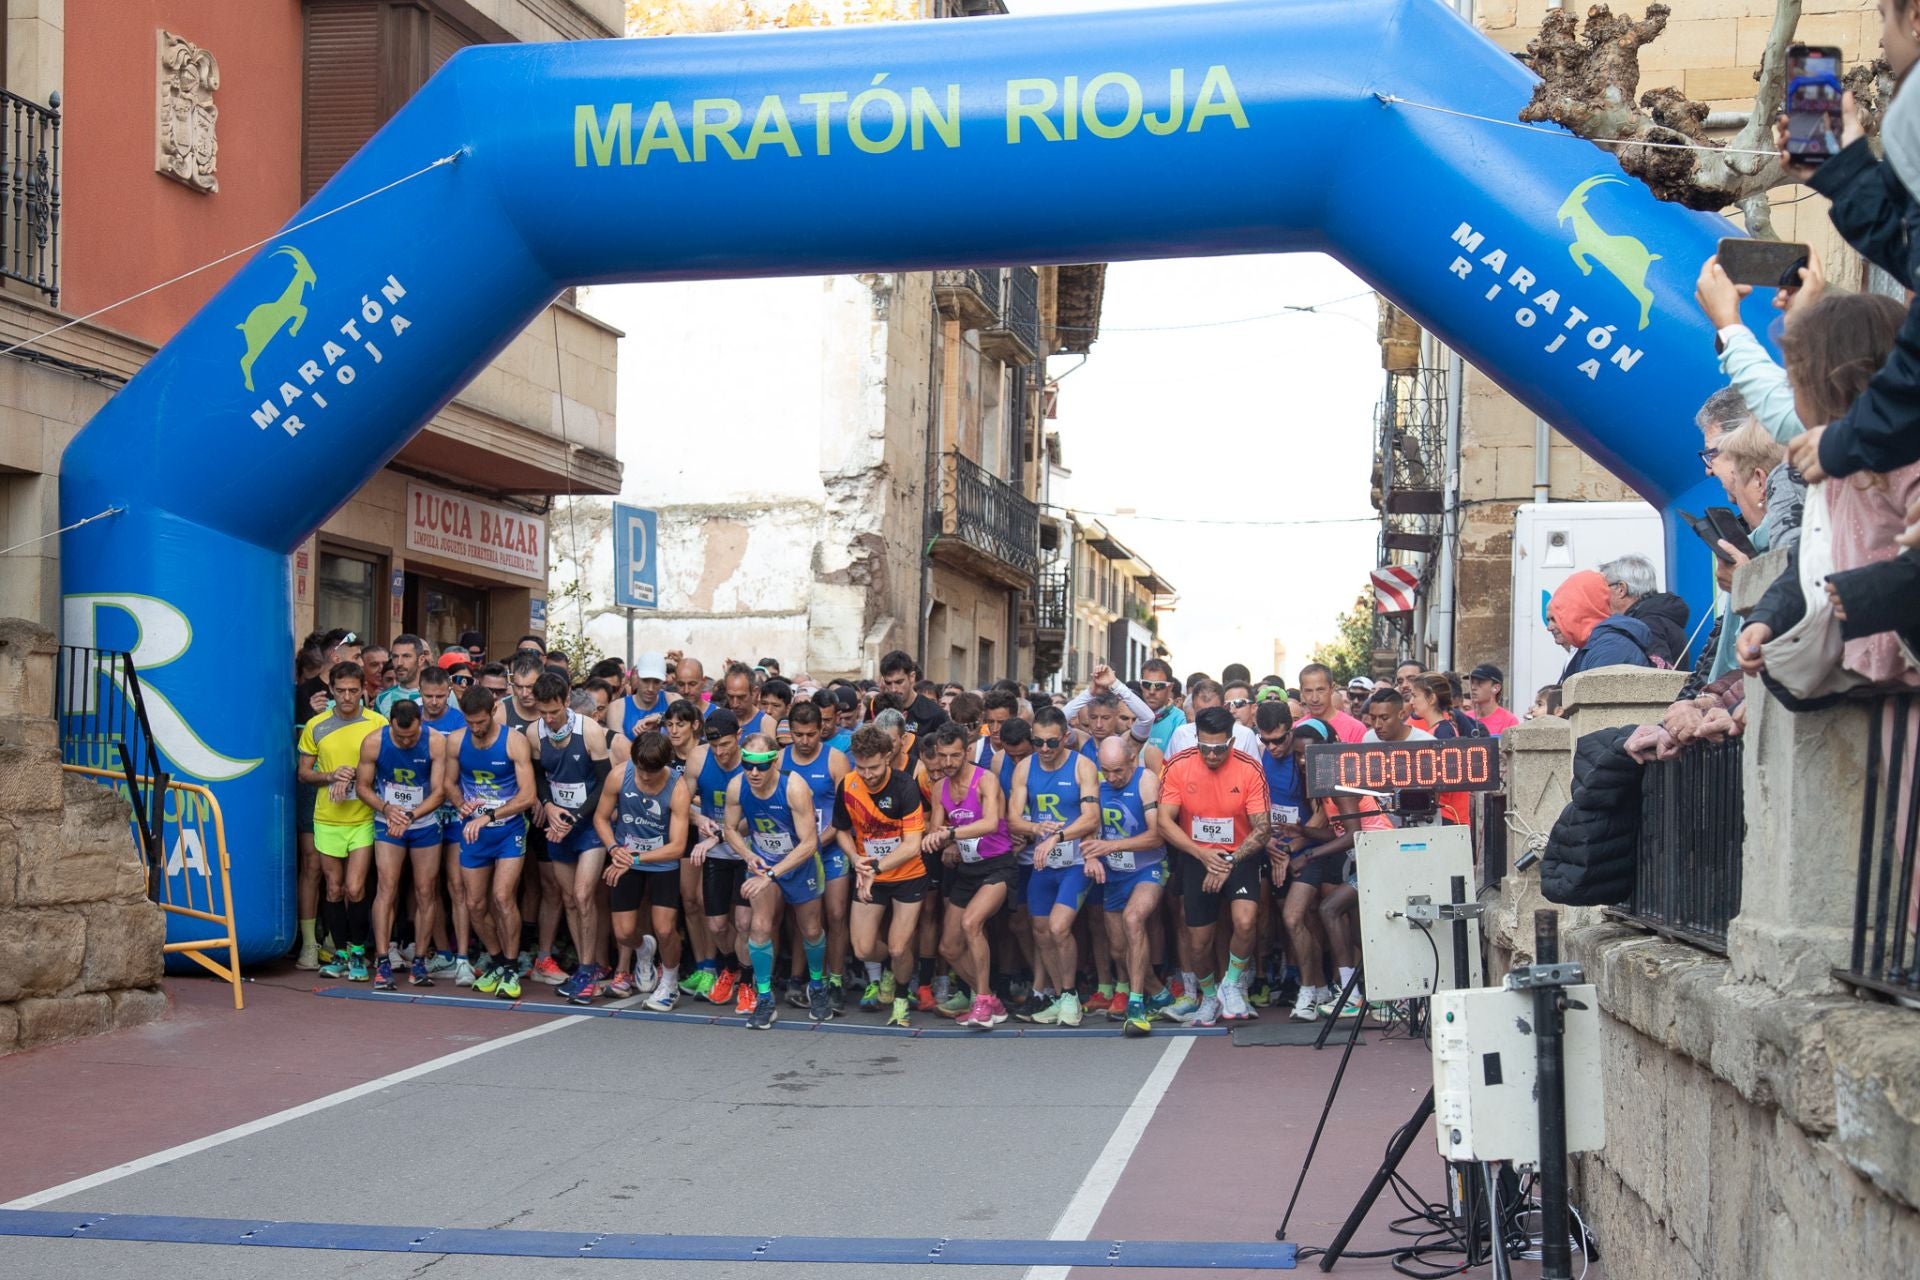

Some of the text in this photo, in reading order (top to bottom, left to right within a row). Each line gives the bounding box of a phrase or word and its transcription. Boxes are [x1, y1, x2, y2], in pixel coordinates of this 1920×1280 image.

[573, 64, 1250, 167] MARATÓN RIOJA
[1450, 221, 1645, 373] MARATÓN
[1448, 255, 1601, 381] RIOJA
[250, 273, 408, 431] MARATÓN
[281, 313, 413, 438] RIOJA
[415, 492, 538, 556] LUCIA BAZAR
[413, 530, 439, 550] LIMPIEZA
[440, 537, 467, 556] JUGUETES
[628, 516, 647, 595] P
[394, 791, 413, 801] 696
[558, 790, 575, 800] 677
[1036, 793, 1068, 821] R
[1102, 807, 1130, 837] R
[1202, 824, 1222, 834] 652
[634, 842, 653, 852] 732
[763, 839, 782, 848] 129
[873, 845, 892, 855] 332
